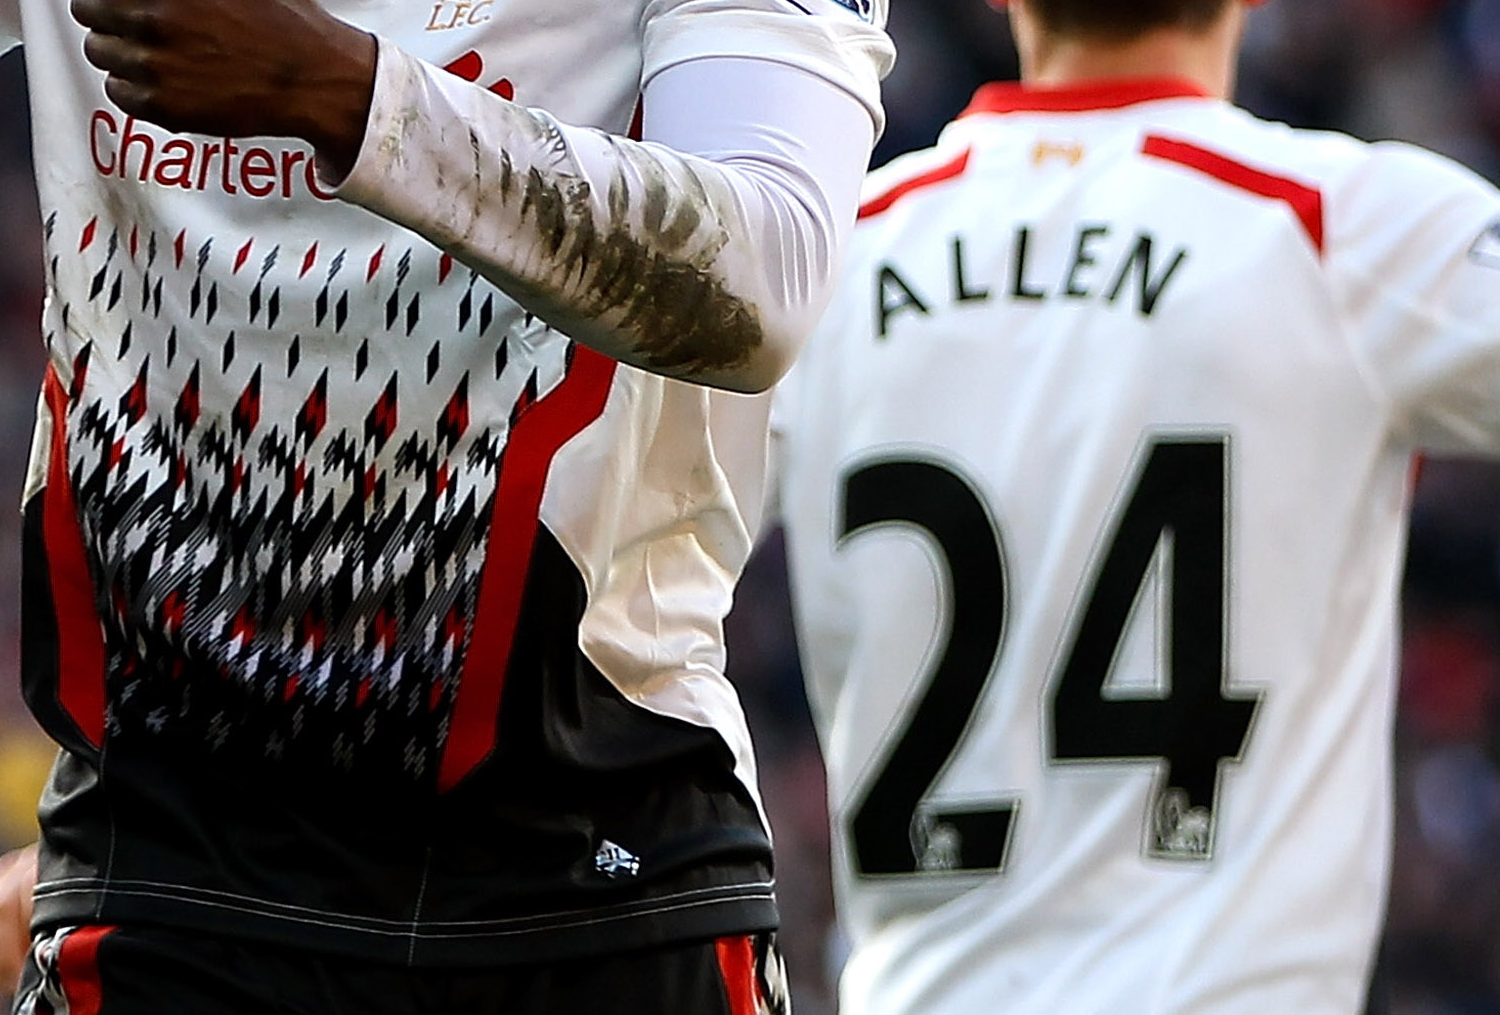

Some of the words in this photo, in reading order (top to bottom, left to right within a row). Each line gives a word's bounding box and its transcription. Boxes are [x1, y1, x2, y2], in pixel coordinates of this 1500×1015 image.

[90, 109, 338, 201] Charter
[874, 224, 1189, 340] ALLEN
[836, 431, 1264, 877] 24
